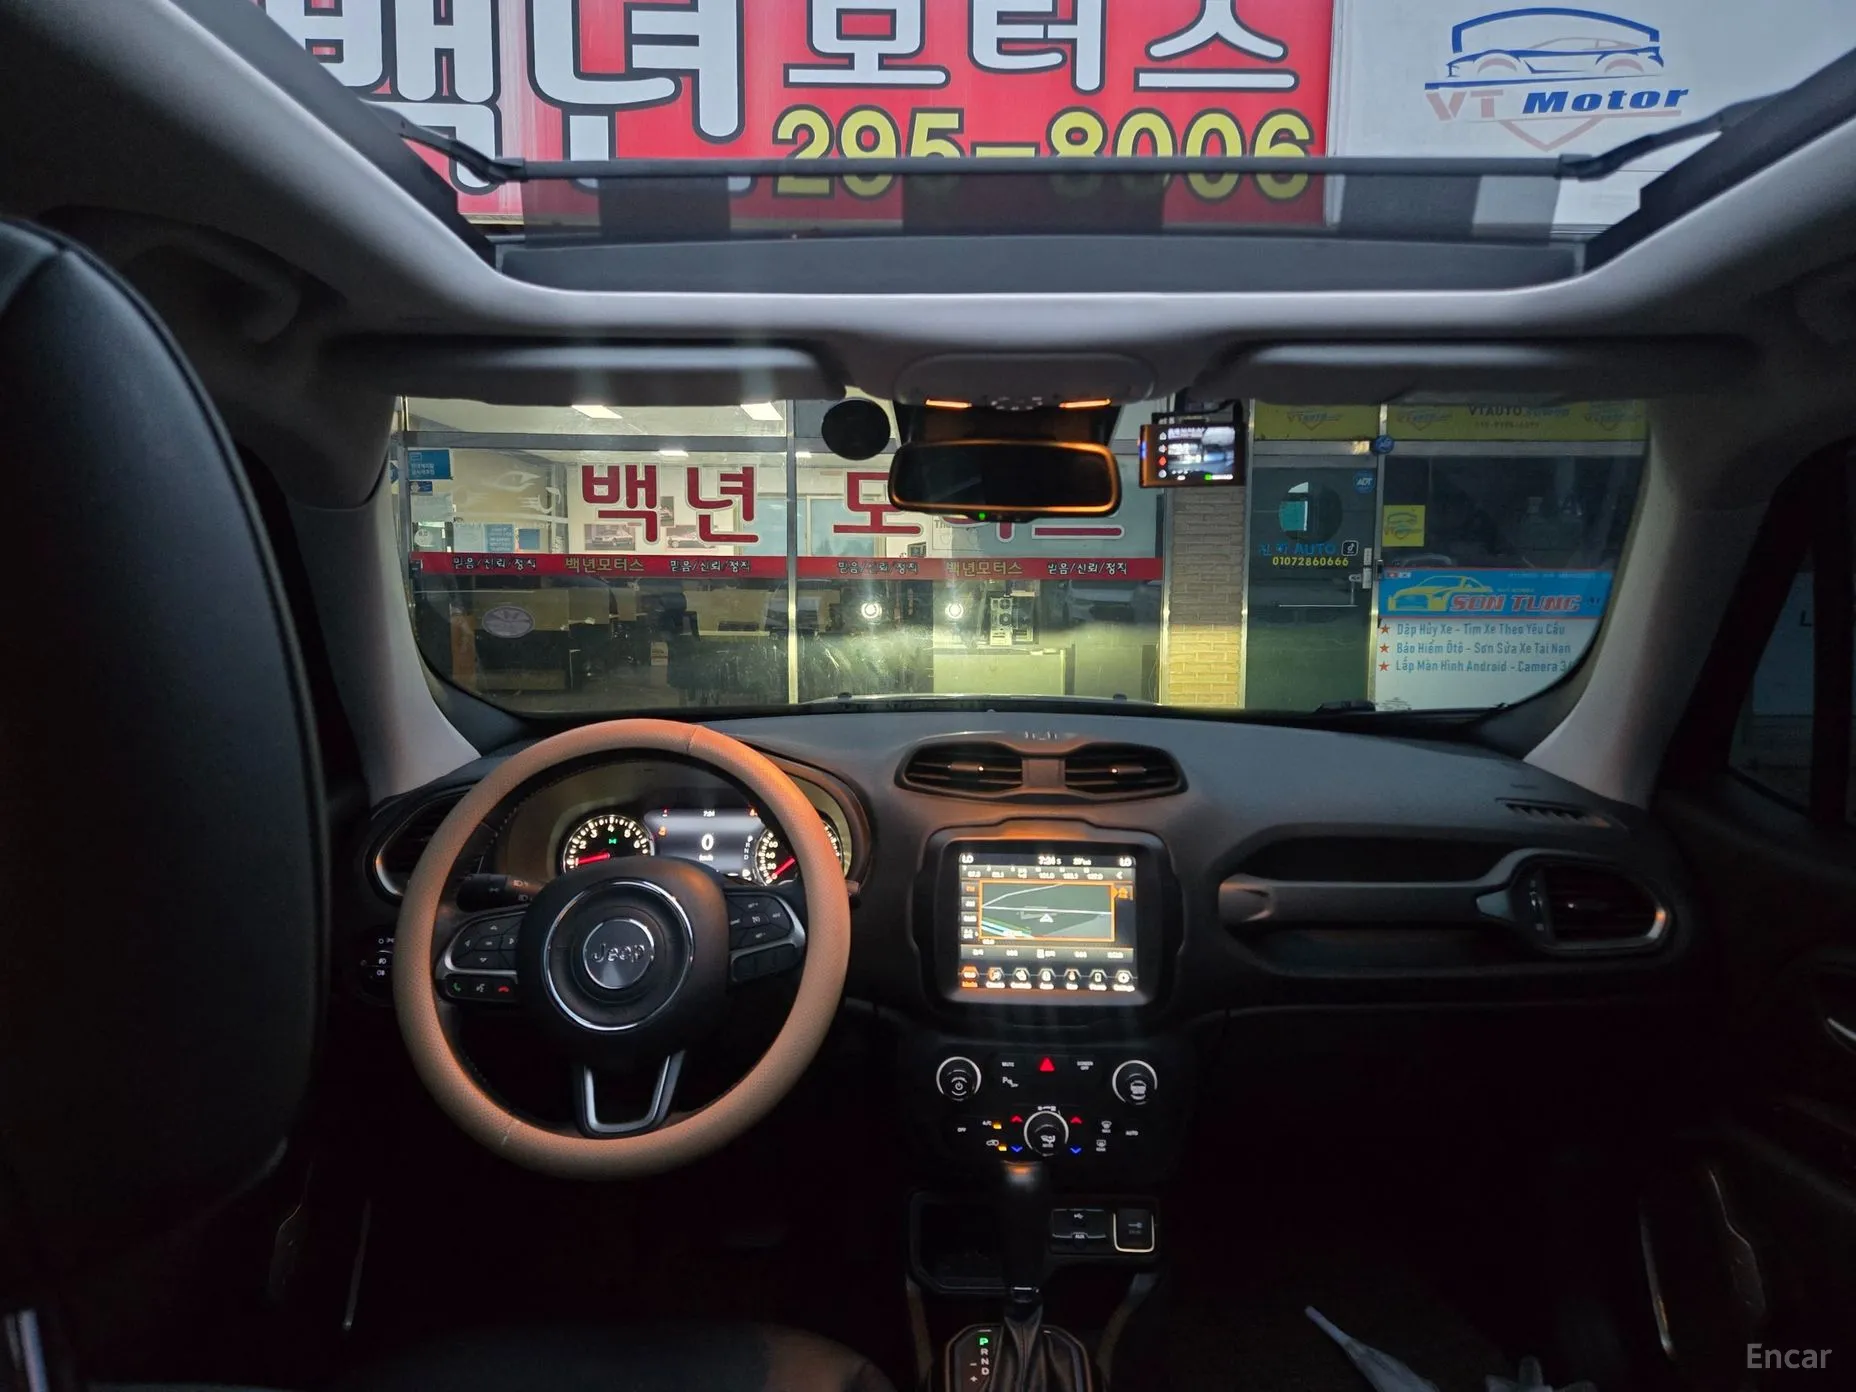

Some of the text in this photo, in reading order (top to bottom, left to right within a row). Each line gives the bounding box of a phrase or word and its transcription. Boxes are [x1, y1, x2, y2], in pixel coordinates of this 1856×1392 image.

[1425, 87, 1689, 122] VT Motor
[582, 464, 758, 544] 백년
[565, 556, 645, 574] 백년모터스
[945, 561, 1024, 576] 백년모터스
[1271, 556, 1350, 568] 01072860666
[1440, 623, 1453, 635] Xe
[1484, 623, 1496, 635] Xe
[1499, 623, 1524, 636] Theo
[1519, 642, 1531, 654] Xe
[1466, 659, 1507, 672] Android
[1518, 660, 1558, 672] Camera
[579, 840, 587, 849] 2
[701, 833, 714, 851] 0
[592, 942, 646, 964] Jeep
[979, 1337, 989, 1346] P
[981, 1367, 989, 1376] D
